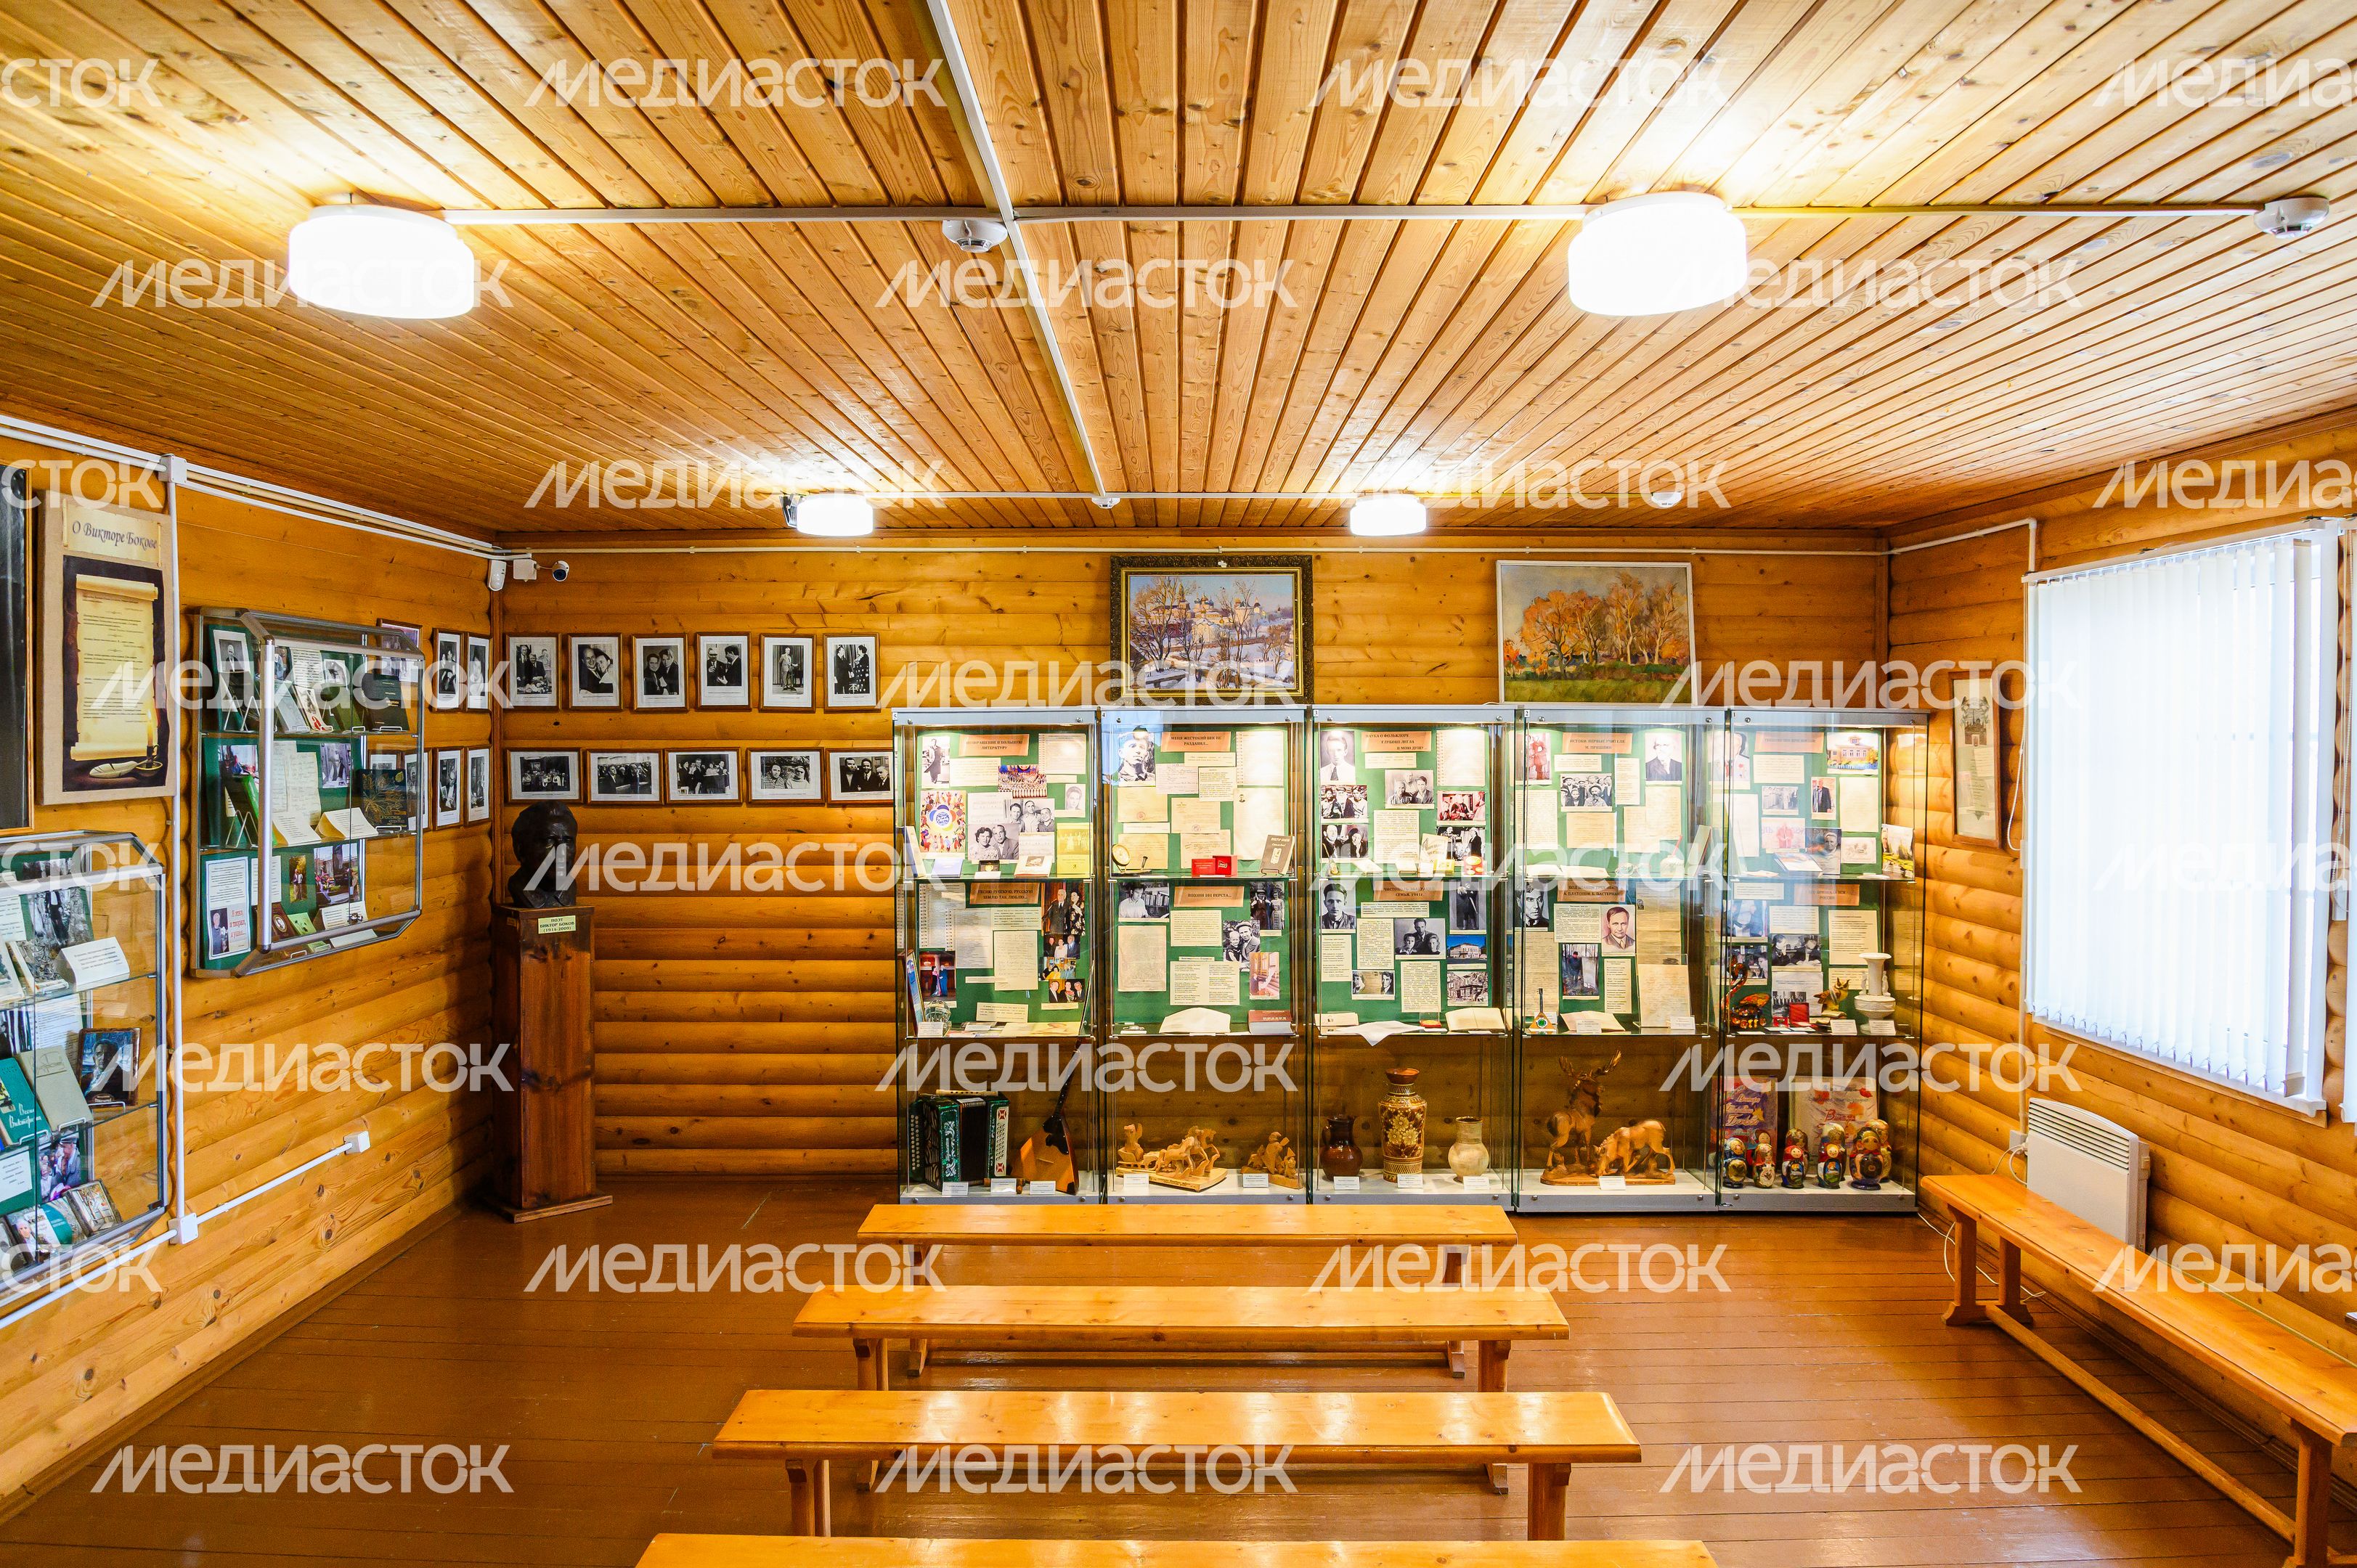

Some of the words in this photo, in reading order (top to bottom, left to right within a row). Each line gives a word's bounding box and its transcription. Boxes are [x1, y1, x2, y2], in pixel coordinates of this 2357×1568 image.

[72, 520, 81, 534] О
[84, 523, 125, 547] Викторе
[126, 532, 158, 550] Бокове
